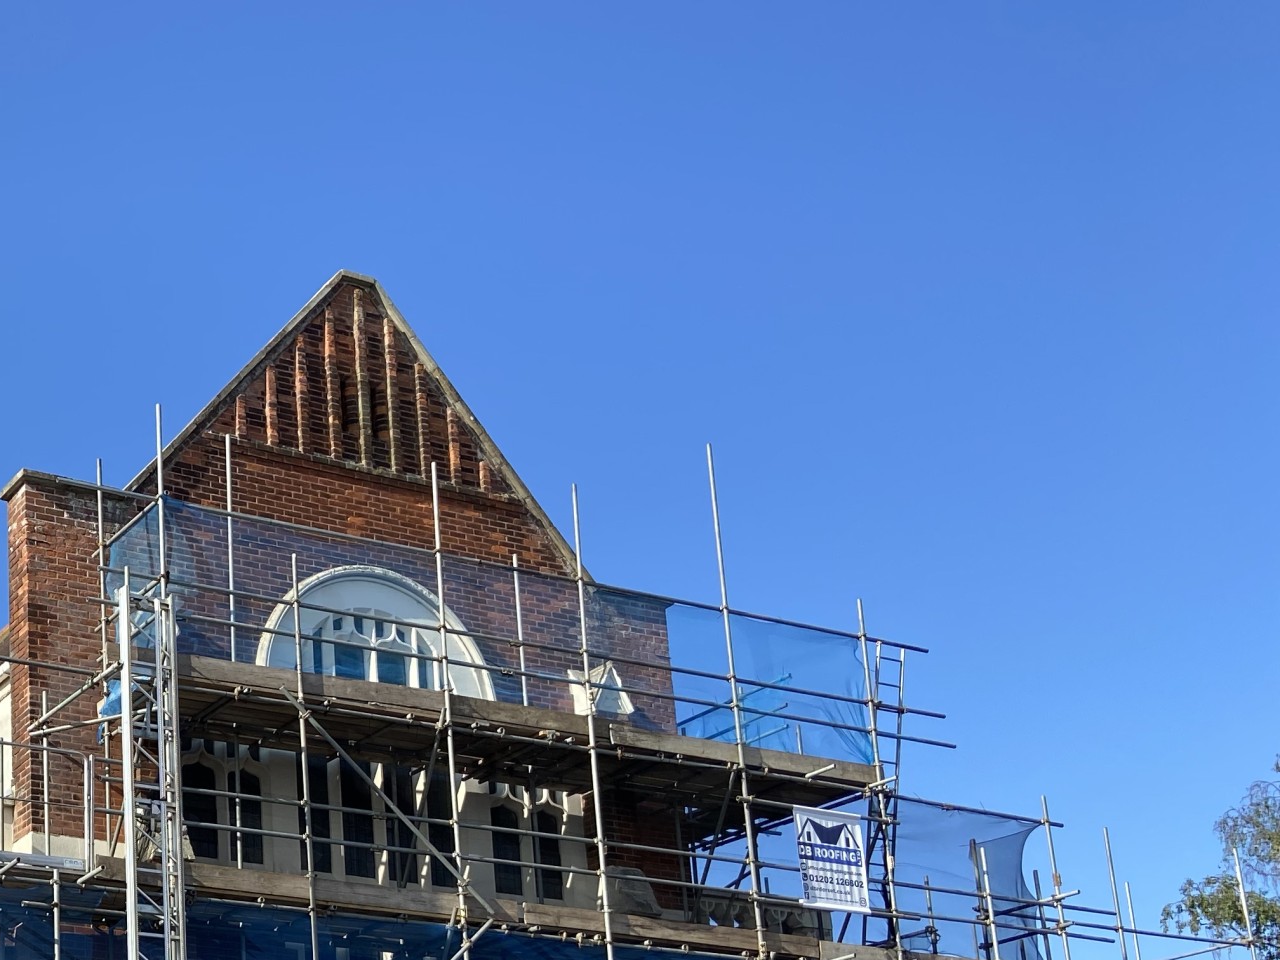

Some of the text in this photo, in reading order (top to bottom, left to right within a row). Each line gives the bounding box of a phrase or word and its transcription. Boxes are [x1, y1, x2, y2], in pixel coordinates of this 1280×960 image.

[799, 845, 856, 862] DB ROOFING
[809, 874, 834, 884] 01202
